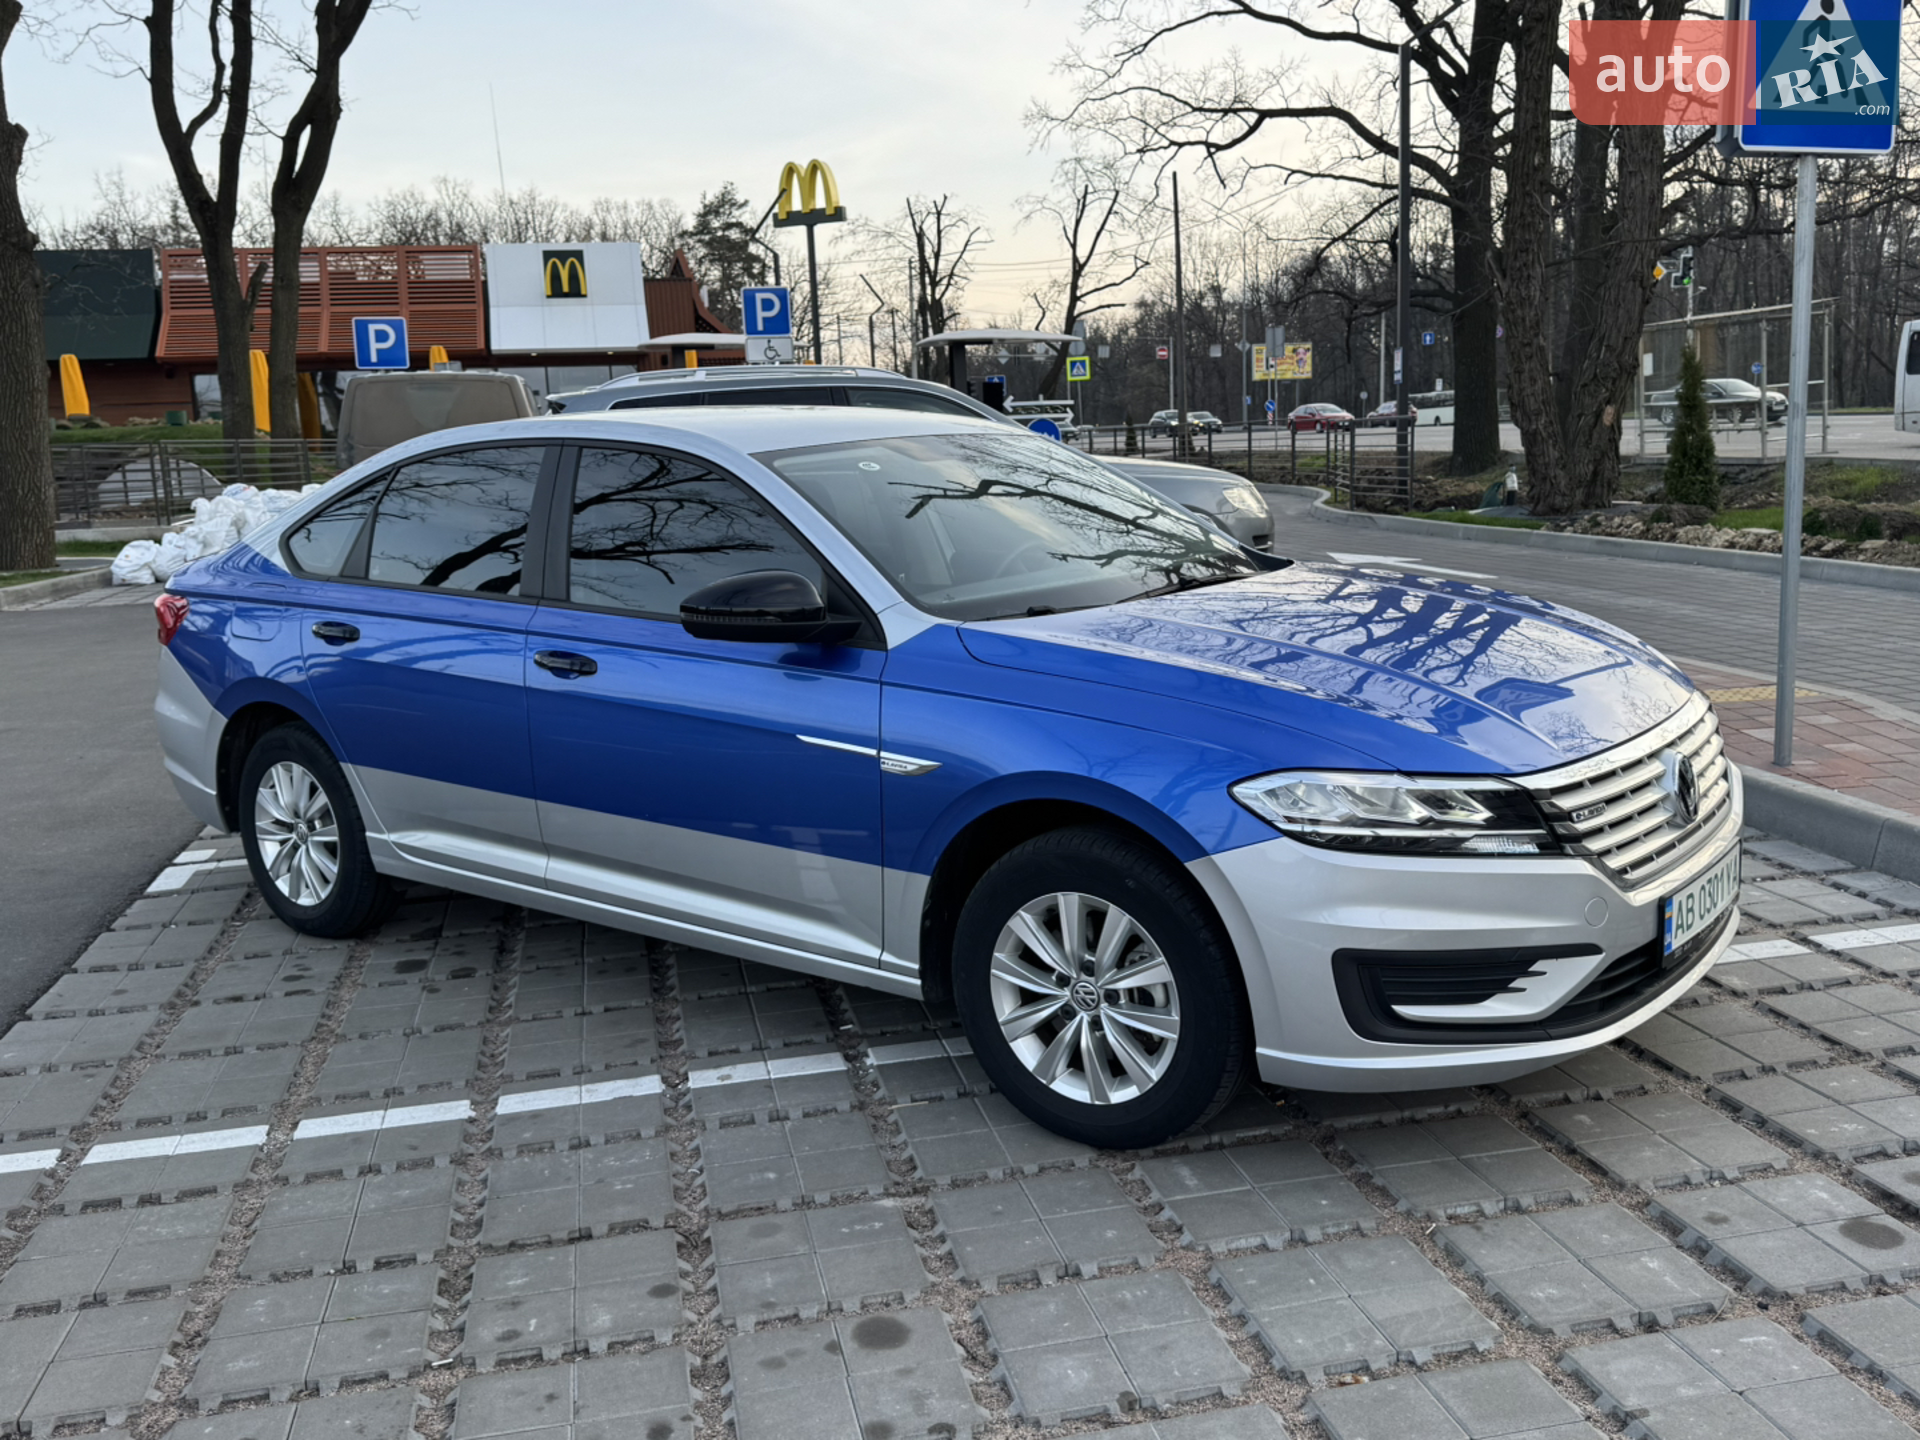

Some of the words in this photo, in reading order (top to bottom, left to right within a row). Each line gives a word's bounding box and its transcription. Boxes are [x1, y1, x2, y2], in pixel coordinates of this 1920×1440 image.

[755, 292, 781, 331] P
[368, 323, 396, 363] P
[1674, 892, 1695, 940] AB
[1699, 867, 1724, 921] 0301
